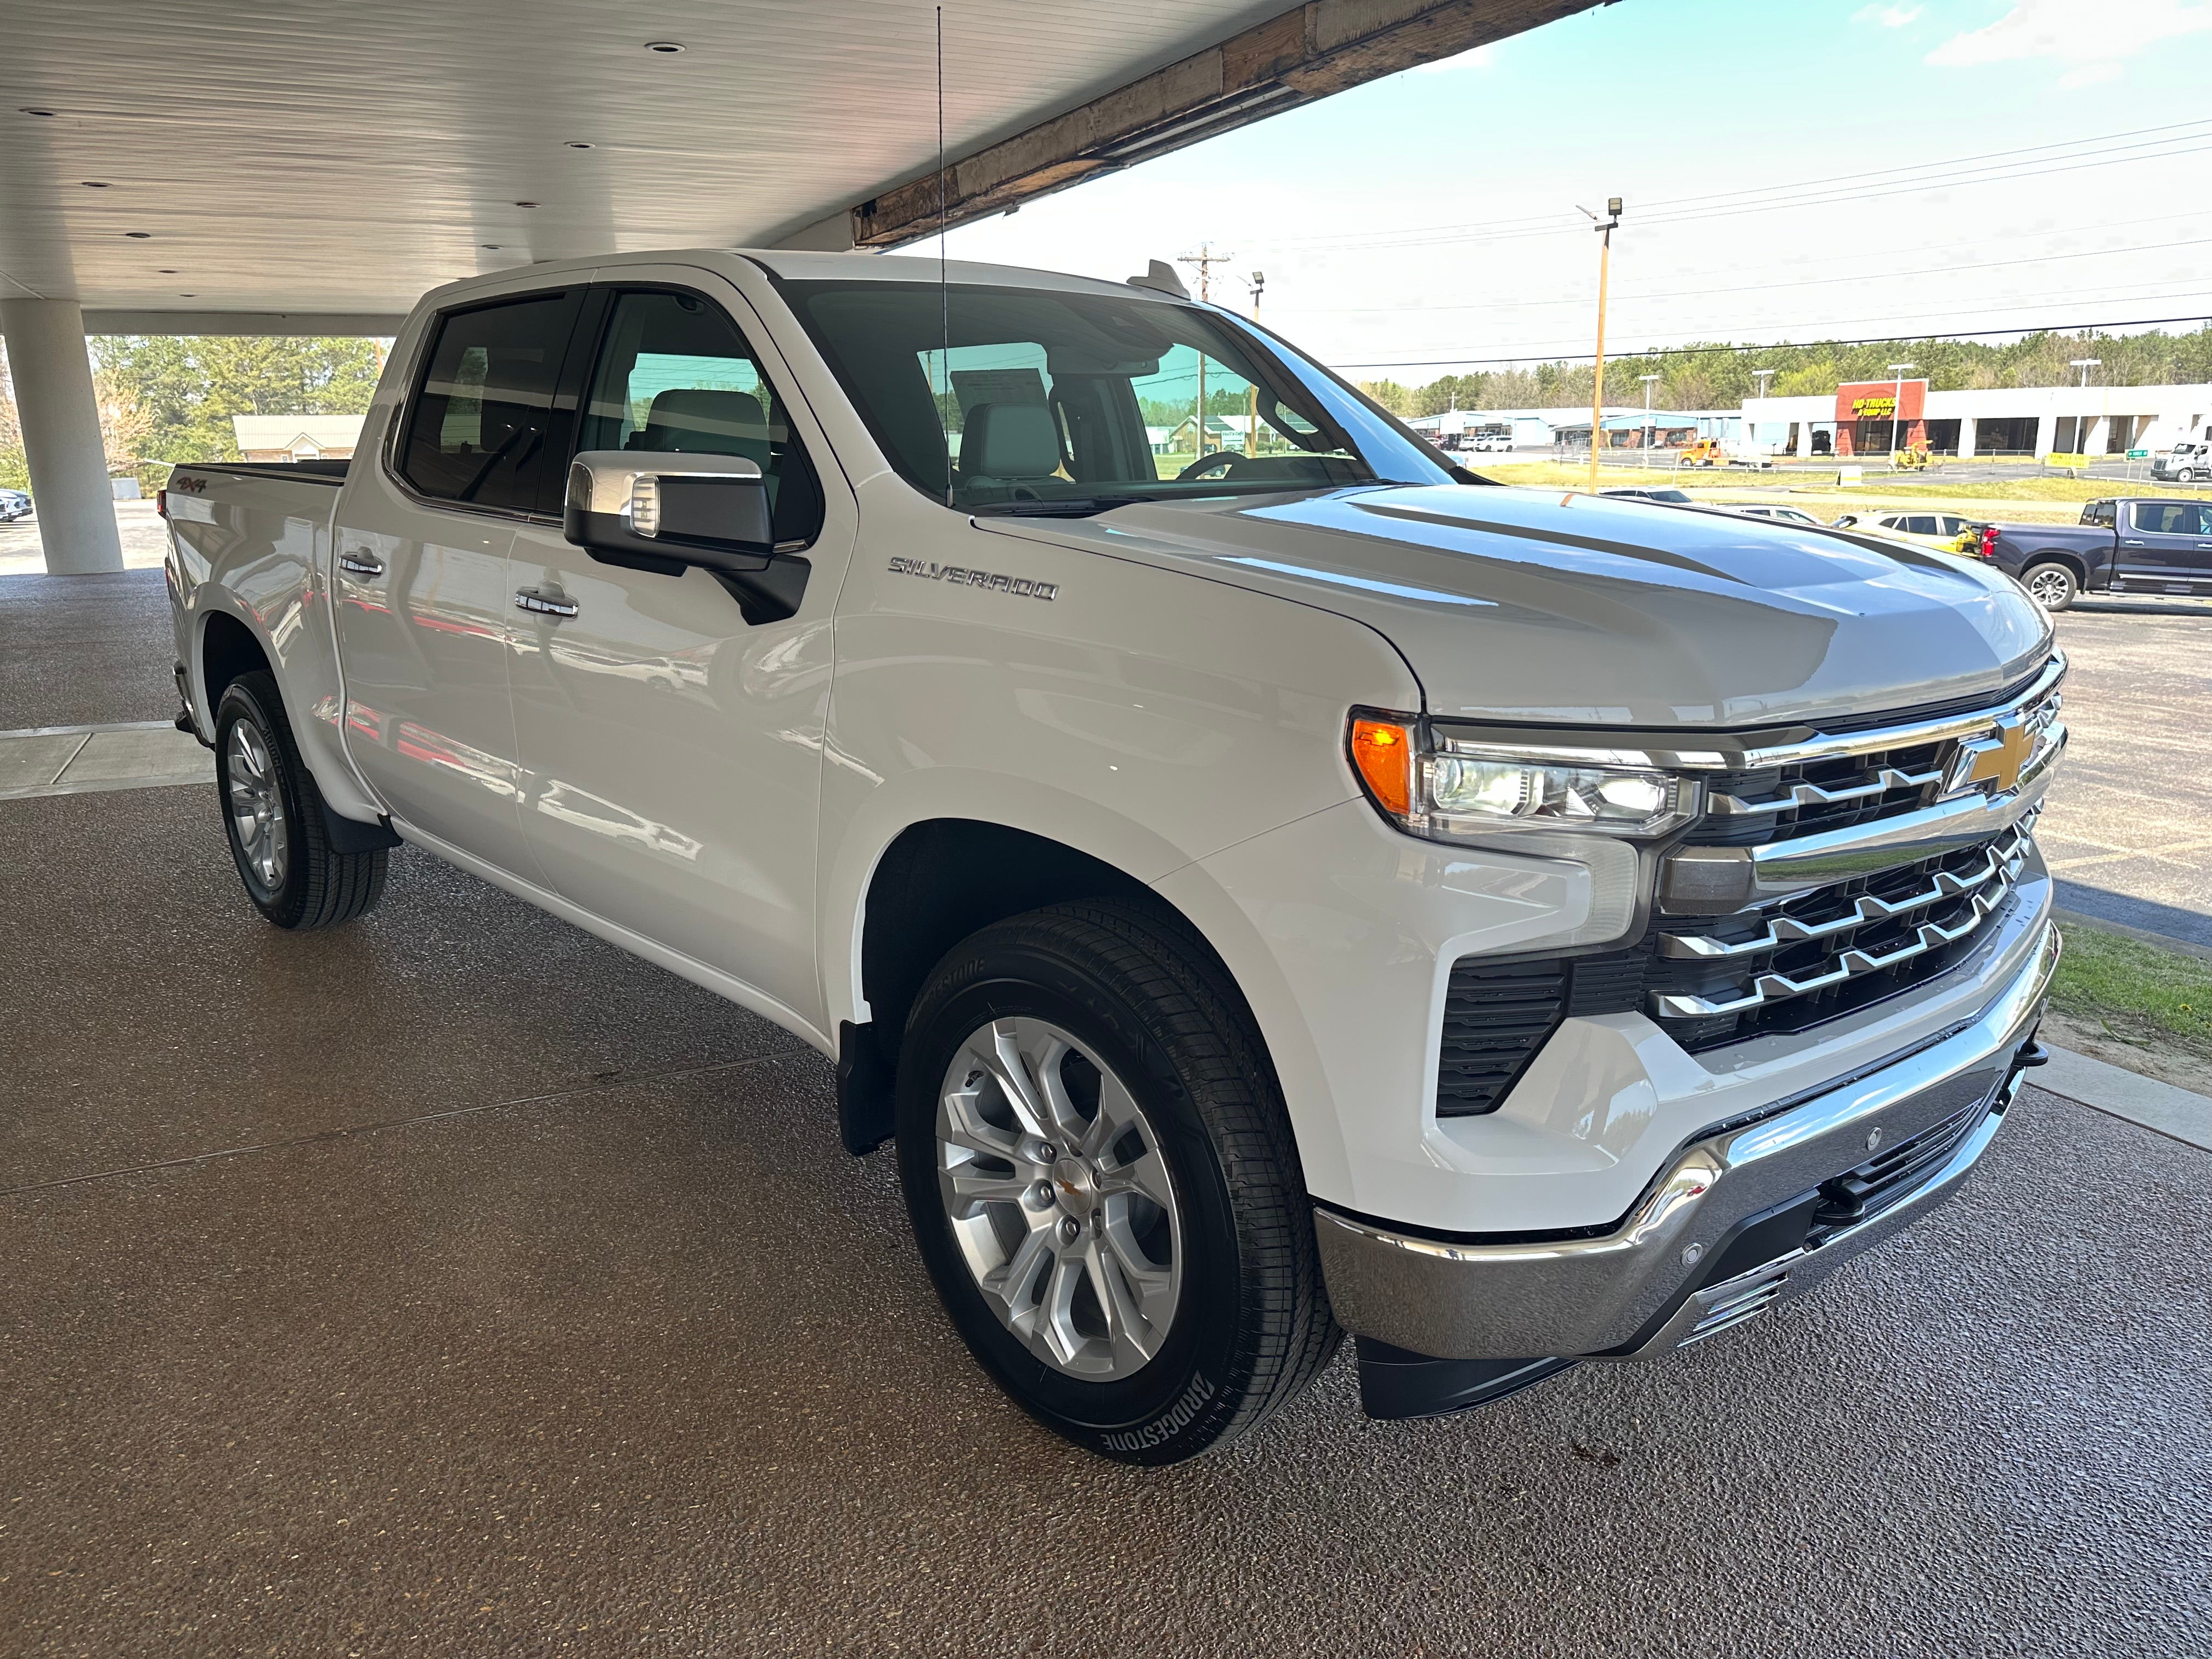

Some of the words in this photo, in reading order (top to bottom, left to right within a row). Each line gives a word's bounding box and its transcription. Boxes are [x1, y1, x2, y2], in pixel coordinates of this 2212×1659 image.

[1880, 408, 1892, 416] LLC
[887, 556, 1060, 601] SILVERADO
[1099, 1369, 1216, 1452] BRIDGESTONE
